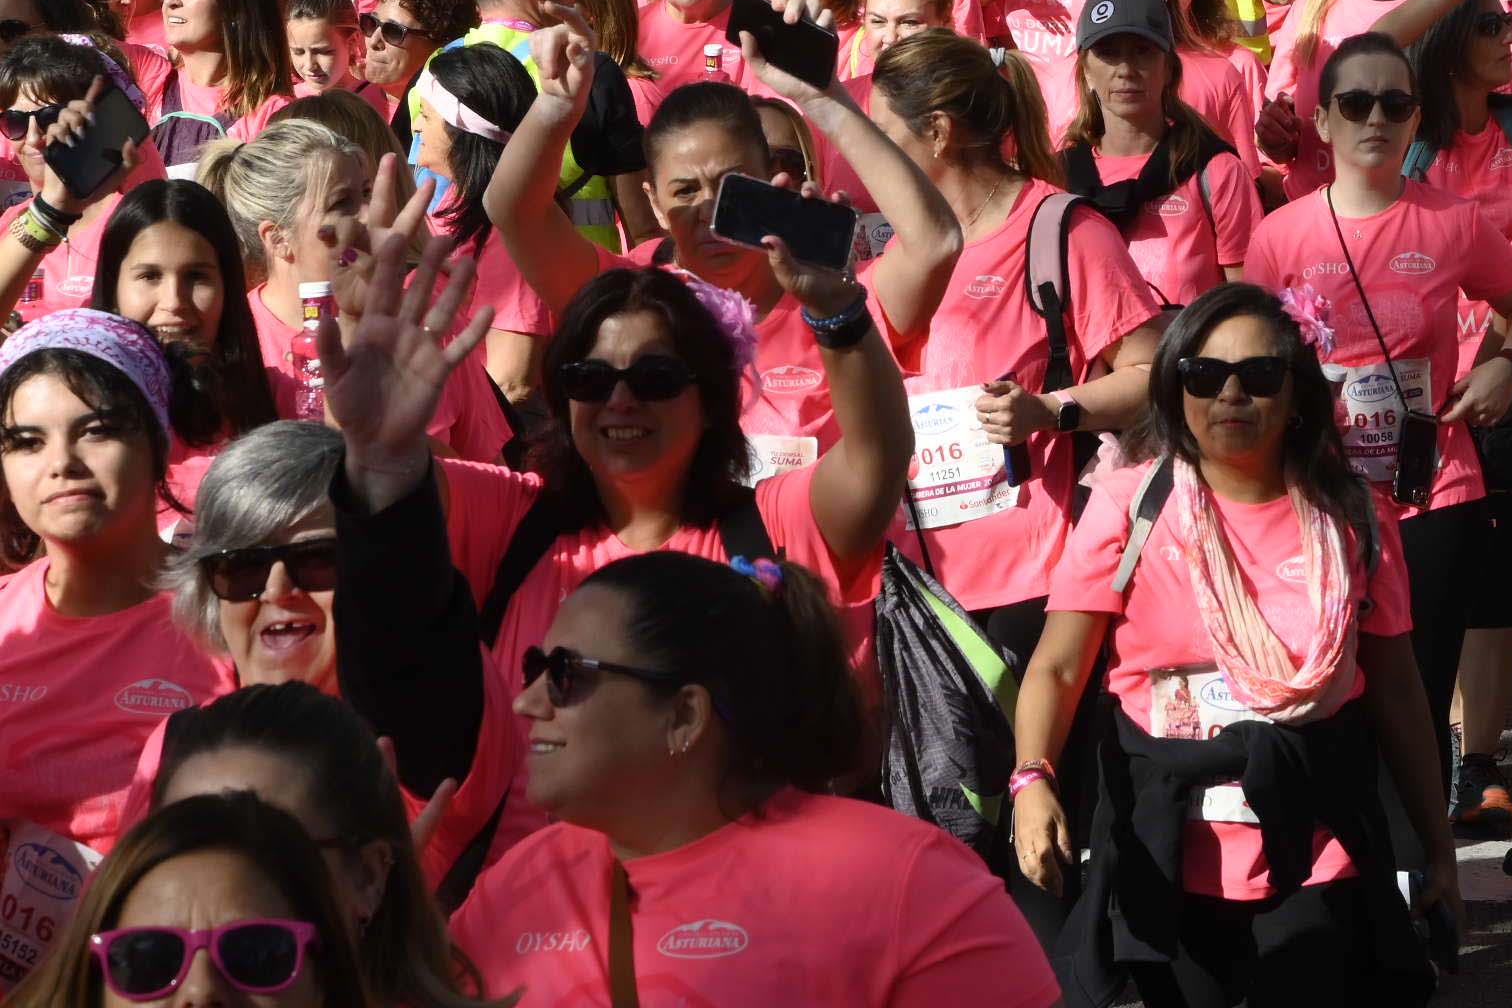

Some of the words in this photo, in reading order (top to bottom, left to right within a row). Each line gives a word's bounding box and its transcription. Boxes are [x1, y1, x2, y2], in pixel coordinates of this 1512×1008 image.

[650, 54, 680, 66] YSHO
[1302, 262, 1350, 282] OYSHO
[1457, 307, 1494, 336] MA
[765, 376, 818, 389] ASTURIANA
[1351, 381, 1396, 398] ASTURIANA
[1353, 410, 1396, 430] 016
[1359, 431, 1394, 445] 10058
[770, 456, 802, 466] SUMA
[921, 442, 964, 467] 016
[929, 467, 963, 481] 11251
[935, 488, 945, 497] DE
[946, 486, 956, 495] LA
[957, 482, 981, 493] MUJER
[968, 488, 1011, 509] Santander
[119, 691, 187, 709] ASTURIANA
[516, 928, 592, 954] OYSHO
[666, 933, 742, 951] ASTURIANA
